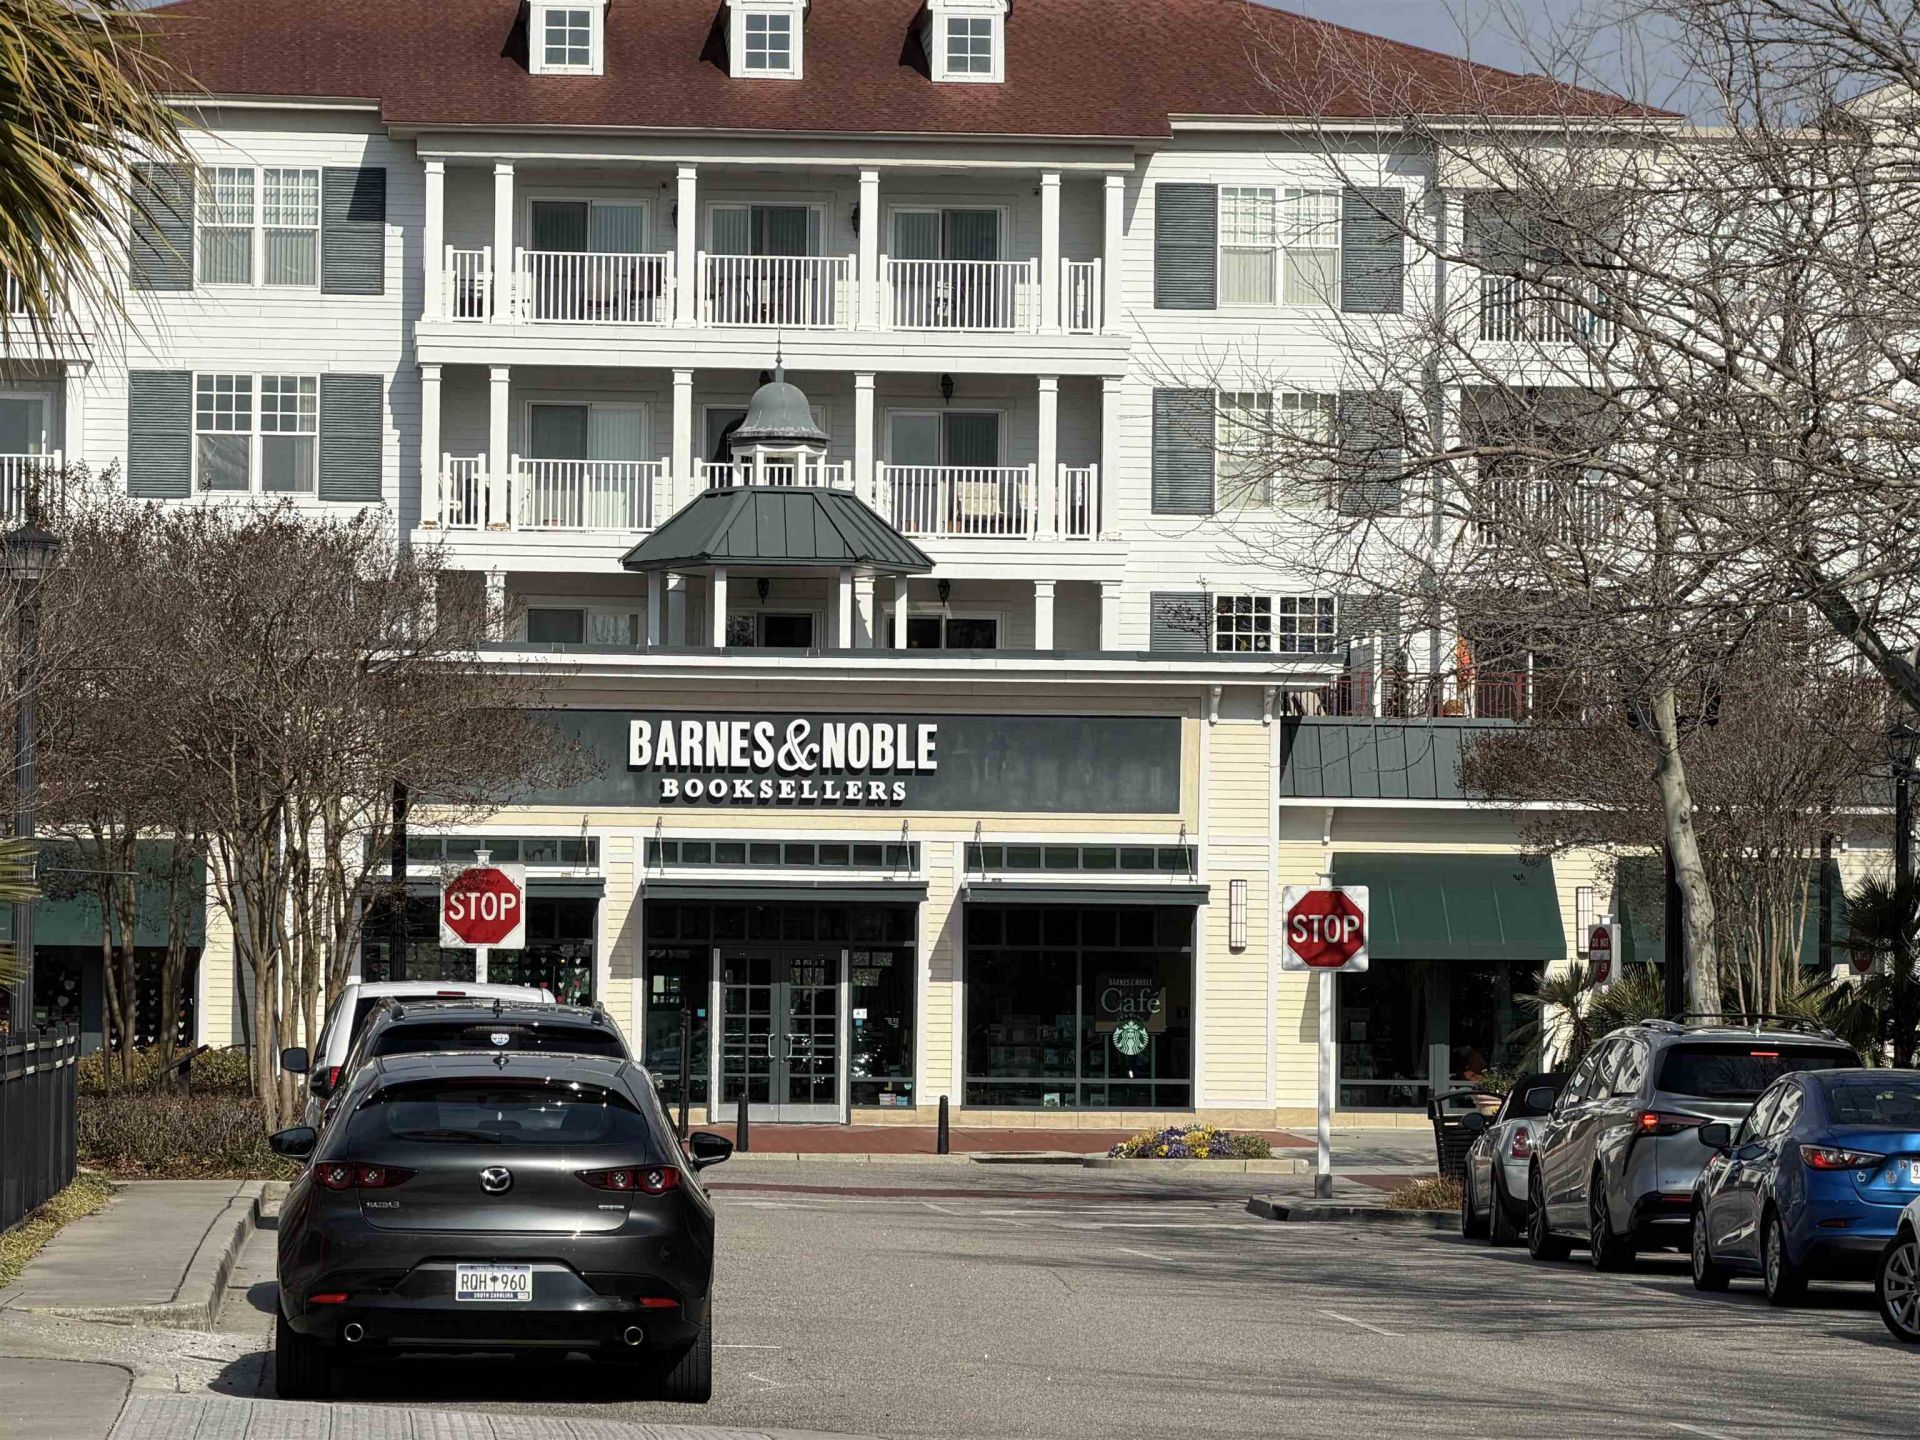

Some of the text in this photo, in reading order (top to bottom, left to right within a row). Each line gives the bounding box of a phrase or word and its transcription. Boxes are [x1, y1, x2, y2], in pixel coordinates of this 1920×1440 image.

[661, 778, 907, 801] BOOKSELLERS
[448, 892, 517, 921] STOP
[1291, 914, 1360, 943] STOP
[1101, 987, 1161, 1014] Café
[501, 1273, 526, 1290] 960
